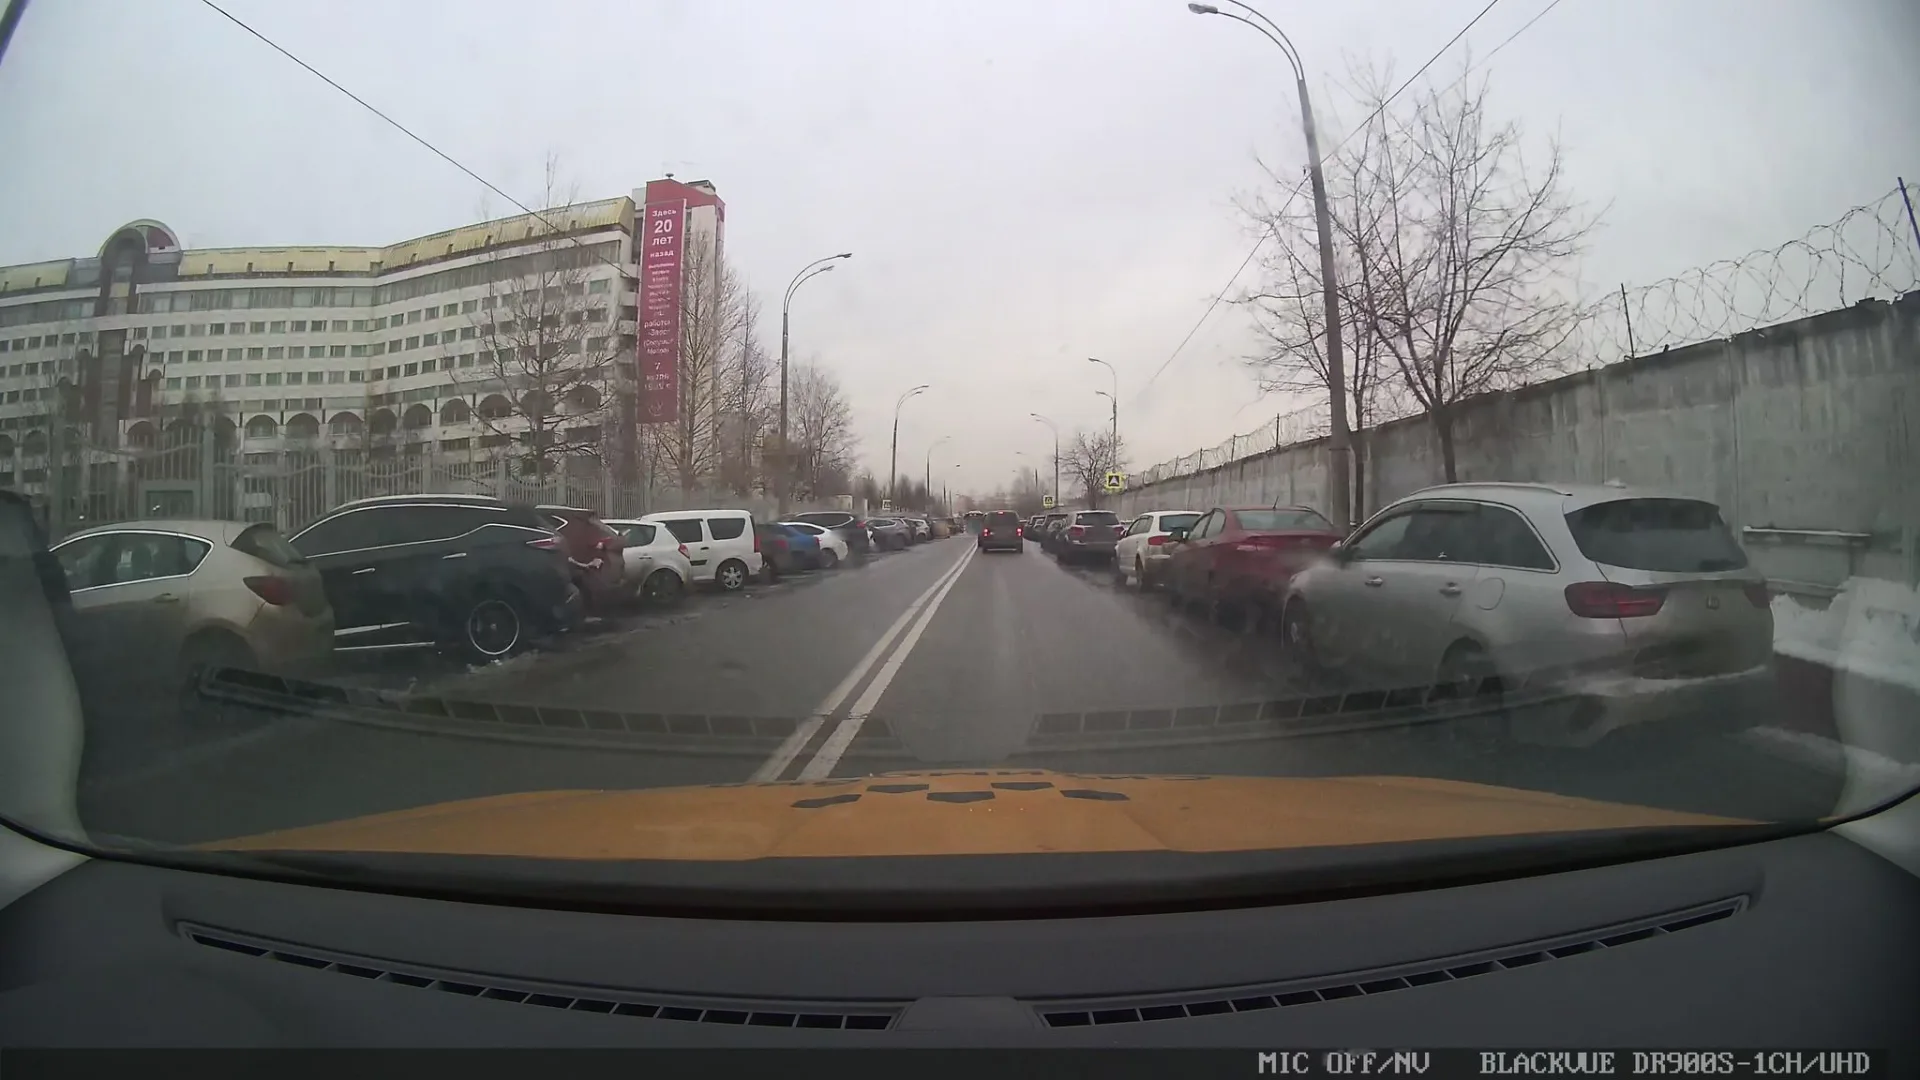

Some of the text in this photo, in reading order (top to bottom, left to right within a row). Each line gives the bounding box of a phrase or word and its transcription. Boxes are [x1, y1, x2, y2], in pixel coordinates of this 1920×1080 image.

[654, 219, 672, 233] 20
[652, 236, 673, 246] лет
[650, 250, 674, 258] назад
